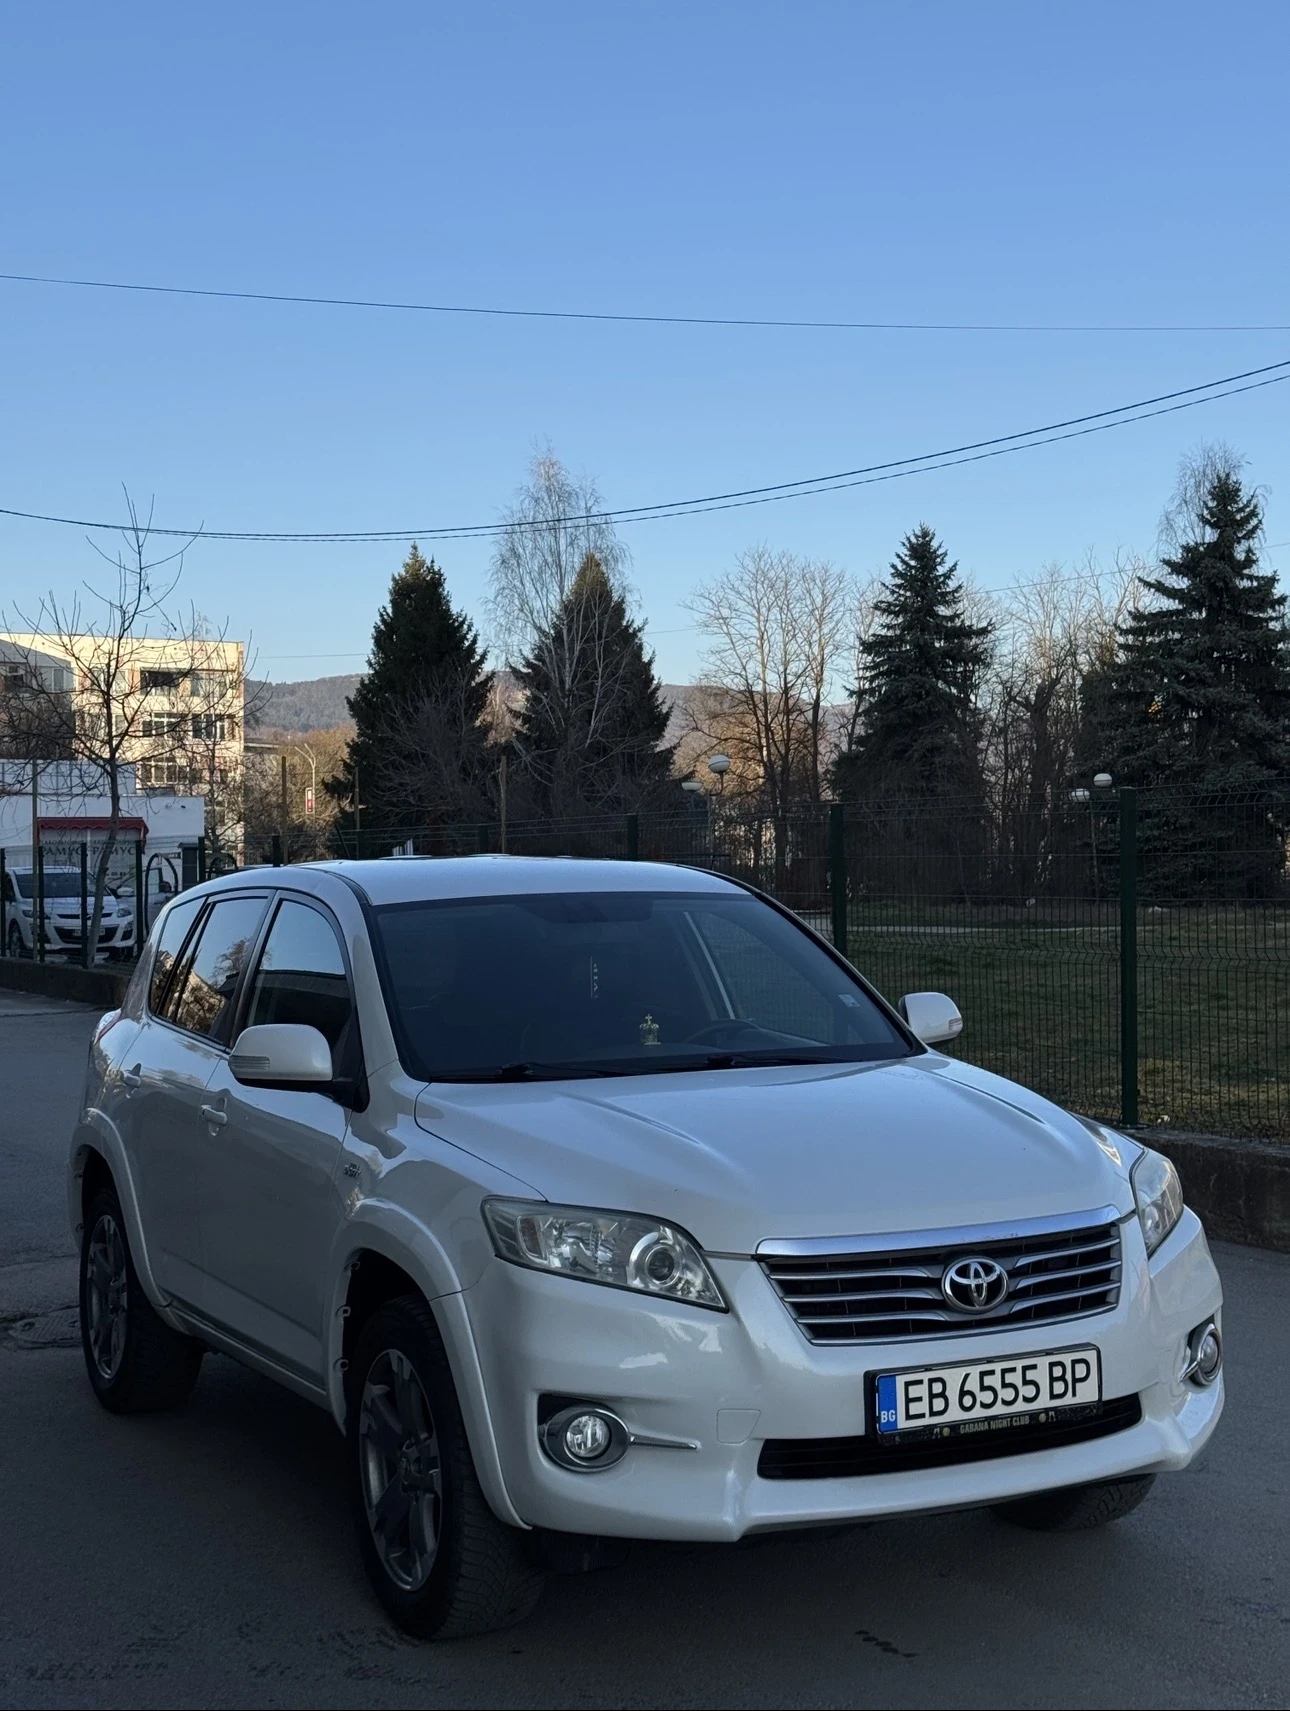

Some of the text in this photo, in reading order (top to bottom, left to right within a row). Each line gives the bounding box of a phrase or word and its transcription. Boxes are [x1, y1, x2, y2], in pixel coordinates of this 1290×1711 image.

[904, 1358, 1091, 1421] EB 6555 BP
[881, 1409, 896, 1423] BG
[990, 1417, 1011, 1430] NIGHT
[1012, 1415, 1030, 1426] CLUB
